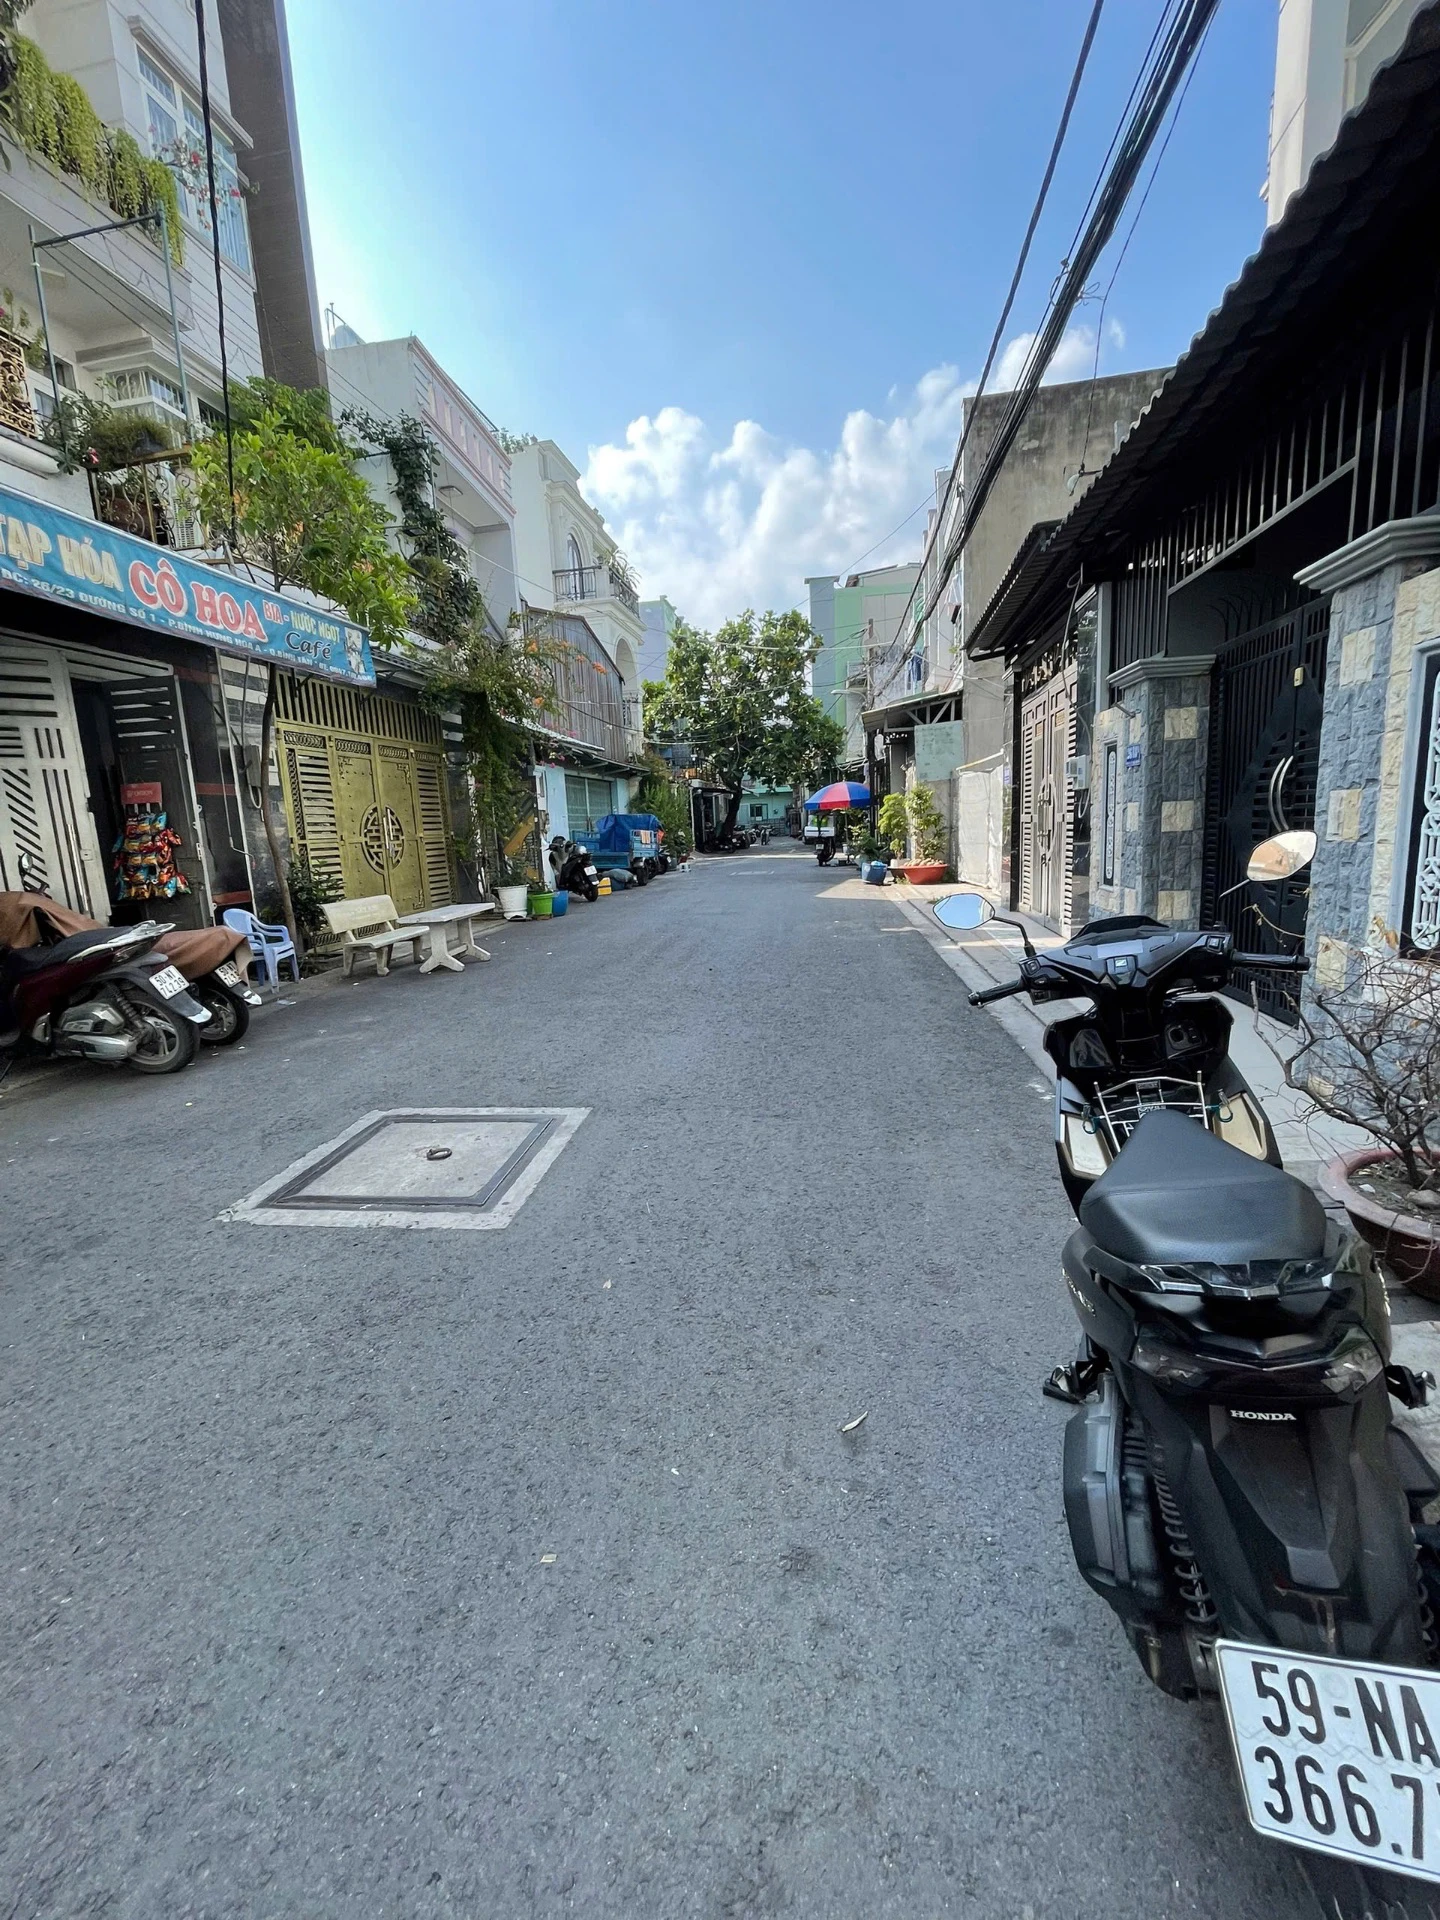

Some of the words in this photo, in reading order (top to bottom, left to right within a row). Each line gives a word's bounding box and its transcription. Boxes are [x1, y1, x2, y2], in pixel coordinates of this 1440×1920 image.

[129, 557, 188, 618] CÔ
[190, 581, 268, 642] HOA
[263, 600, 283, 625] BIA
[318, 621, 340, 645] NGỌT
[285, 631, 332, 660] Café
[1230, 1409, 1297, 1421] HONDA
[1251, 1661, 1440, 1768] 59-NA
[1255, 1746, 1440, 1860] 366.7
